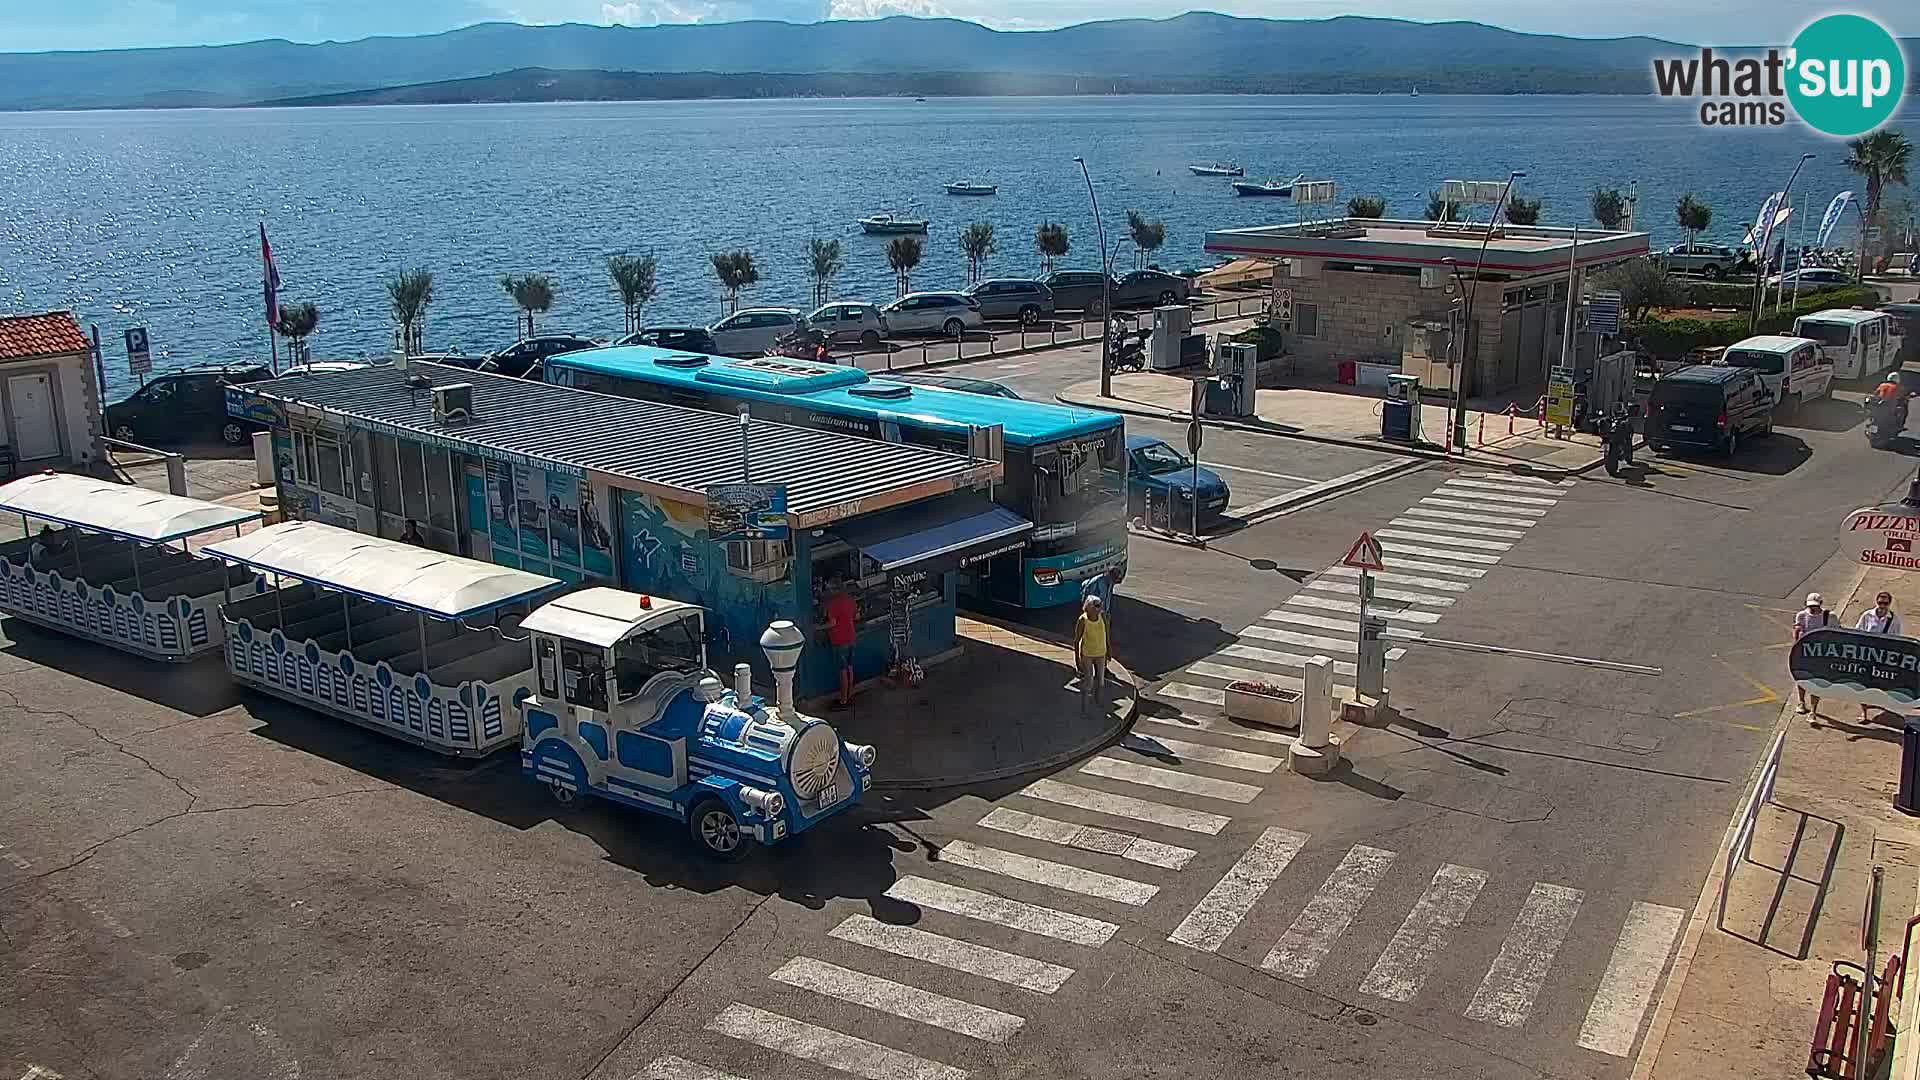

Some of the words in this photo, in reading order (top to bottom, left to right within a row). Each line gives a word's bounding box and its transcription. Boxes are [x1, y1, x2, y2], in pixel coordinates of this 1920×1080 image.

[130, 331, 143, 350] P
[478, 447, 494, 458] BUS
[494, 450, 527, 465] STATION
[529, 457, 556, 471] TICKET
[556, 464, 583, 477] OFFICE
[1849, 514, 1920, 534] PIZZE
[1802, 643, 1920, 672] MARINER
[1871, 665, 1899, 681] bar
